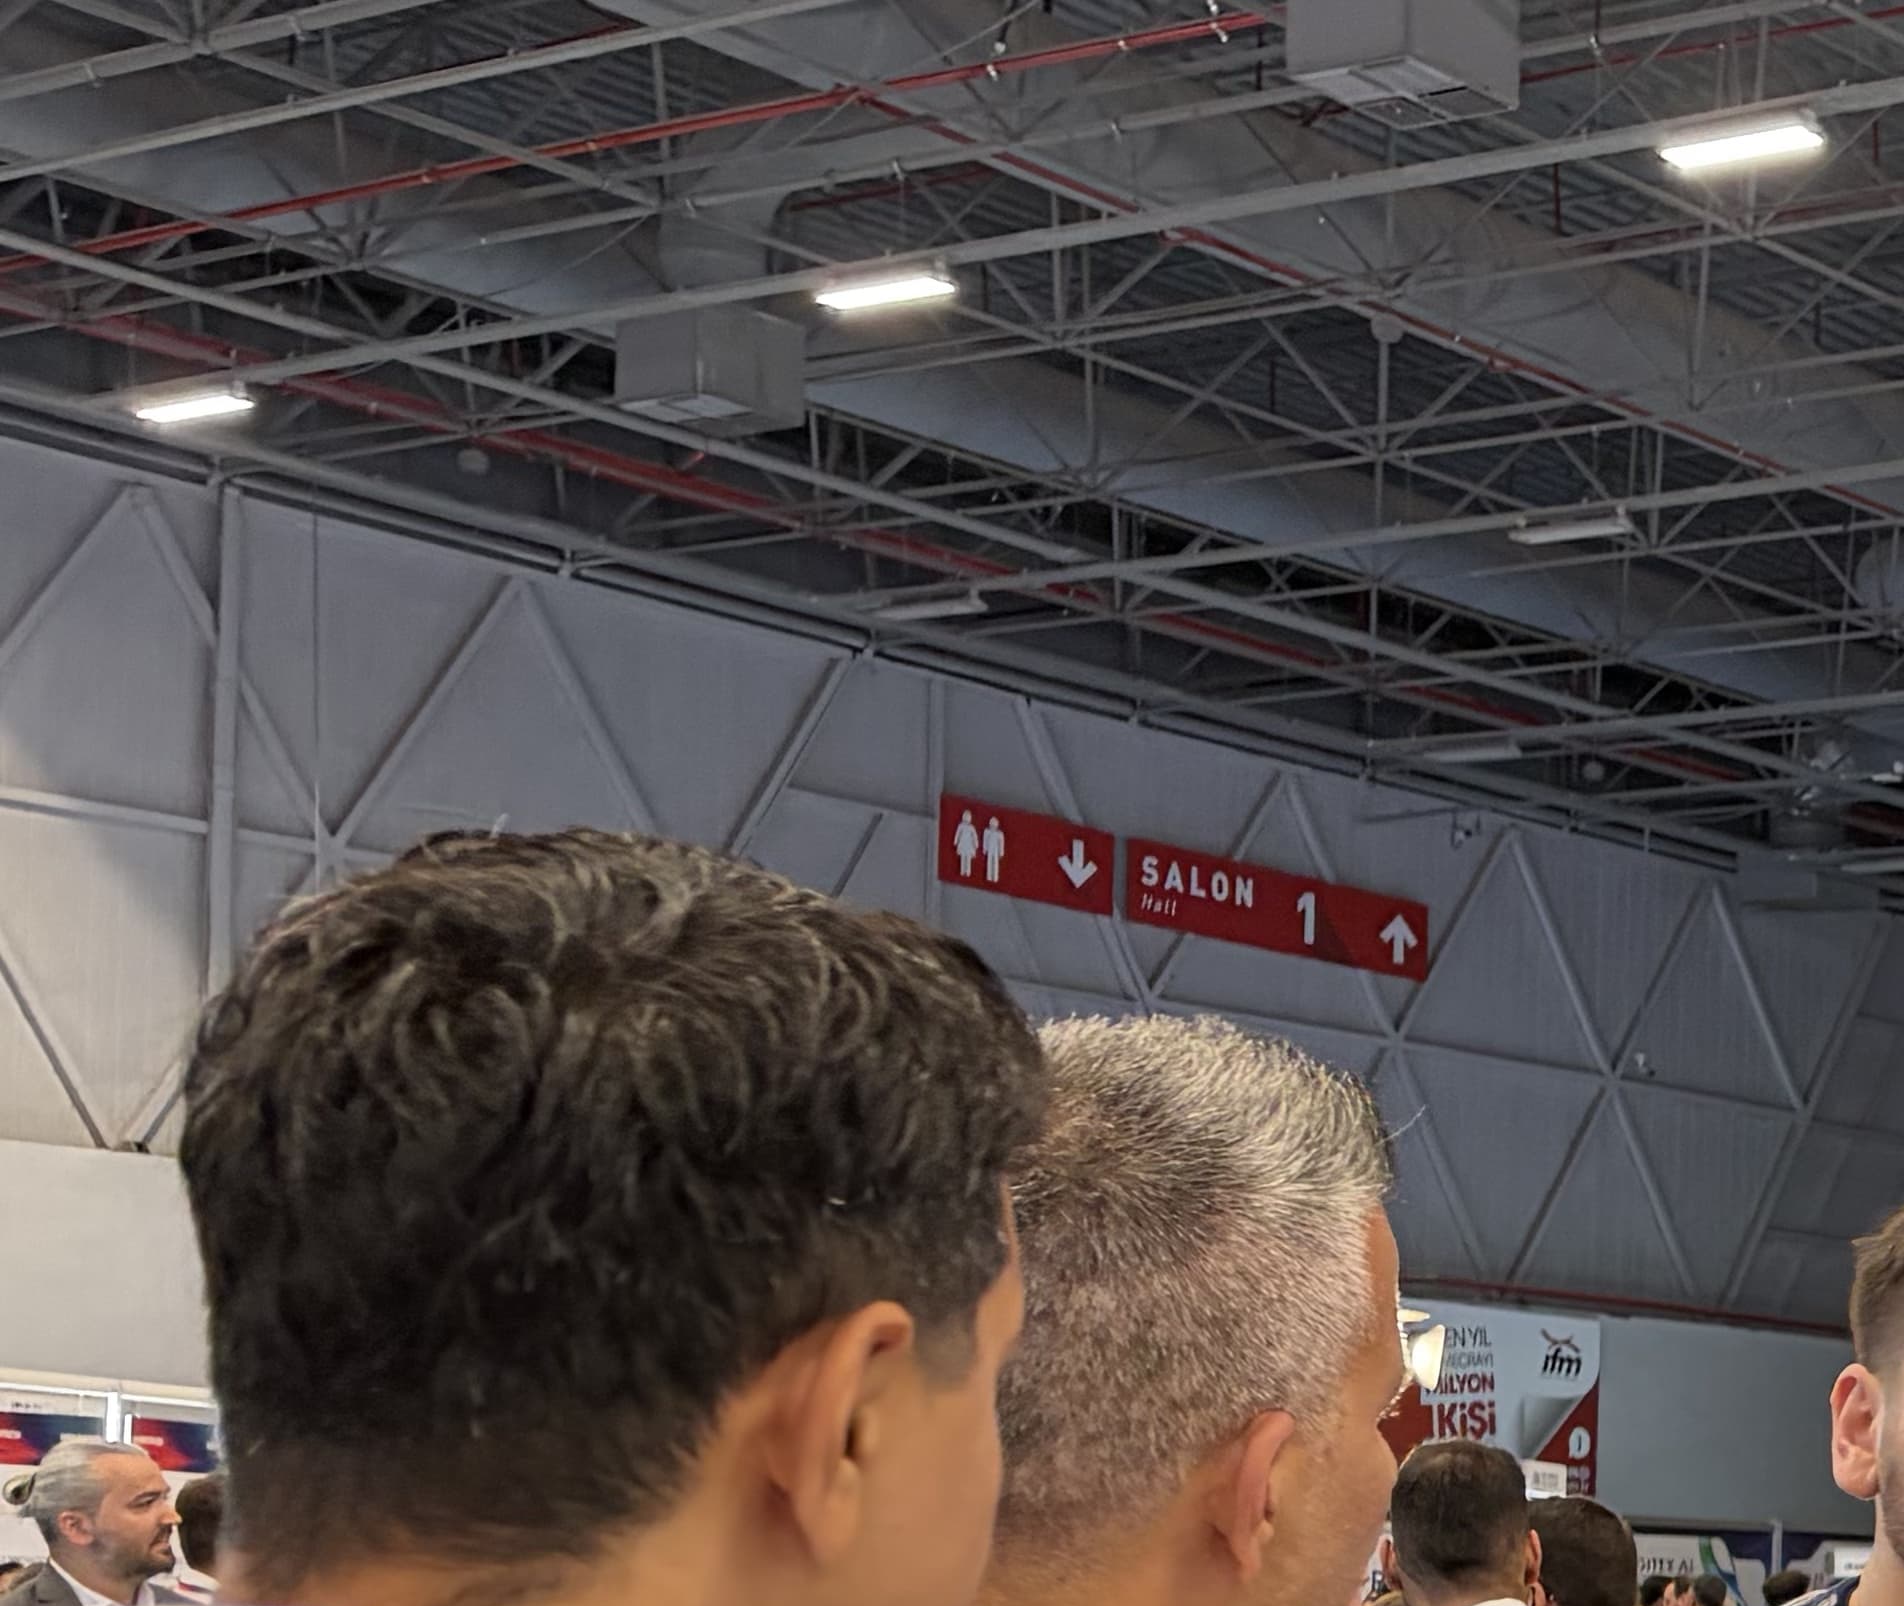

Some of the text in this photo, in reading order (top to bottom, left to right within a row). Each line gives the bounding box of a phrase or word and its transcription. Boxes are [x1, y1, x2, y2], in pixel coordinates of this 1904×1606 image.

[1141, 856, 1315, 945] SALON 1
[1142, 893, 1176, 916] Hall
[1542, 1348, 1582, 1376] ifm
